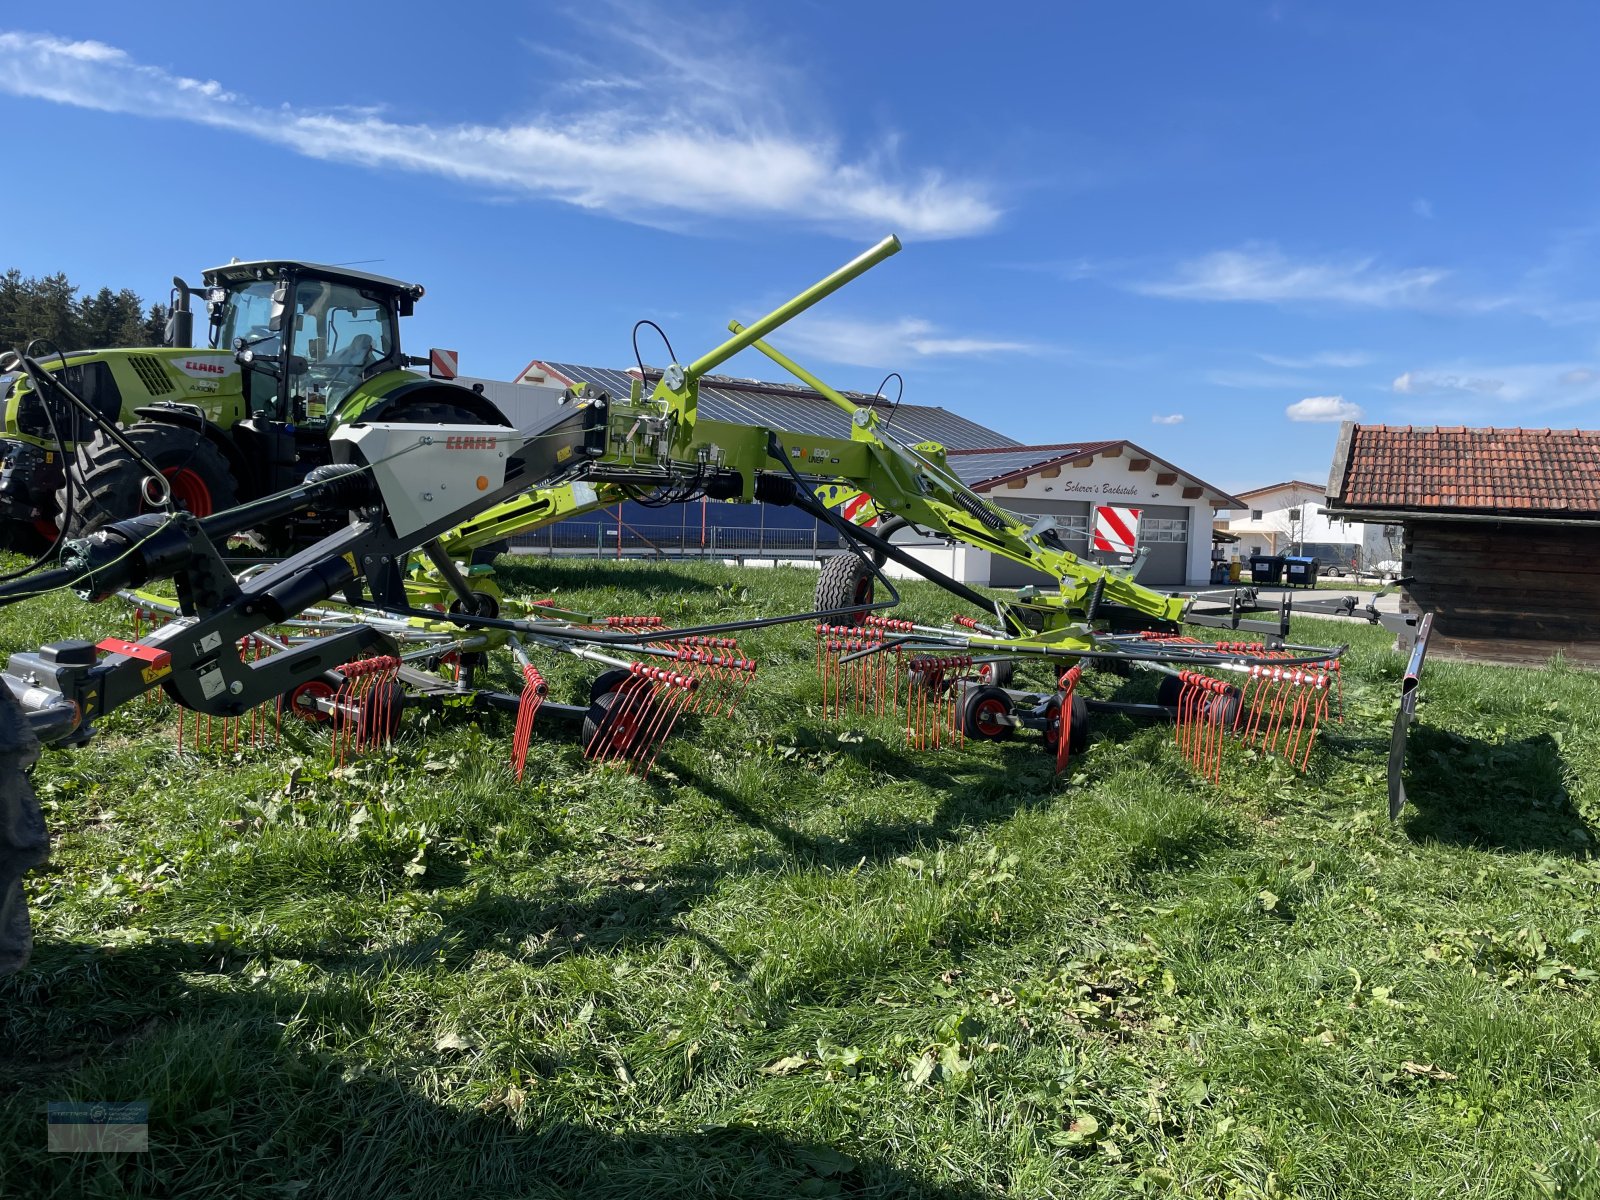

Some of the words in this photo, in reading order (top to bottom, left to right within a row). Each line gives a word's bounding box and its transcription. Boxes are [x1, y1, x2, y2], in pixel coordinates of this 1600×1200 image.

[185, 361, 225, 374] CLAAS
[189, 384, 216, 394] AXION
[446, 436, 497, 450] CLAAS
[808, 455, 824, 464] LINER
[1102, 483, 1138, 496] Backstube
